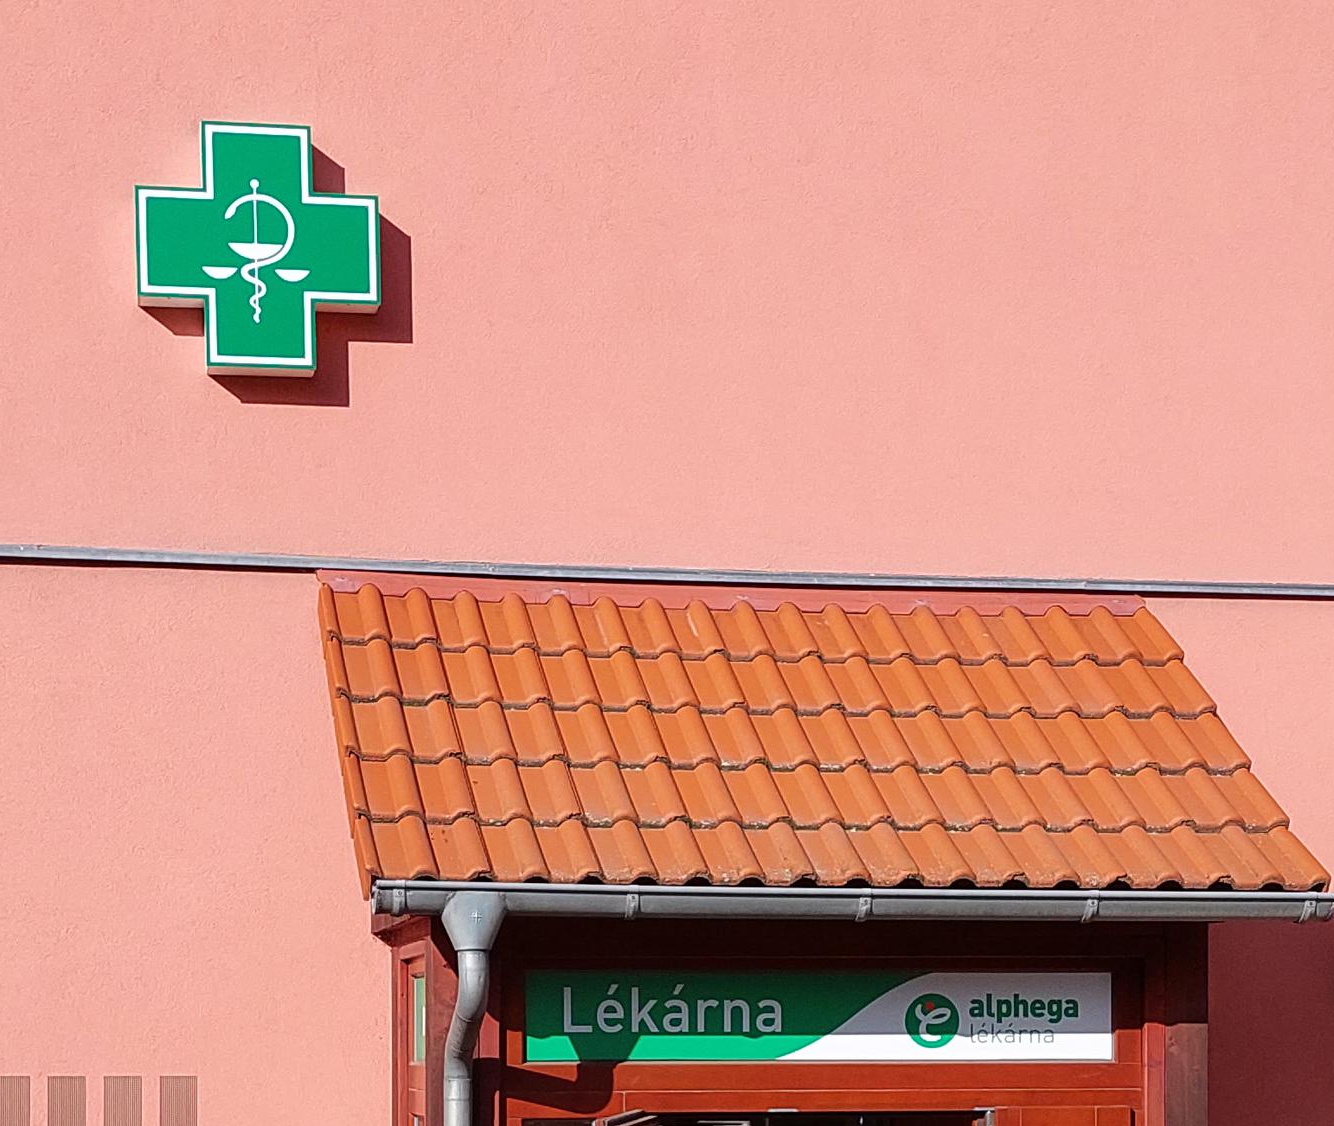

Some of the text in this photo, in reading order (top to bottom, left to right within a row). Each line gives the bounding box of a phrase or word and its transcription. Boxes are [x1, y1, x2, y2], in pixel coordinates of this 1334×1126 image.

[562, 983, 783, 1034] Lékárna
[968, 993, 1079, 1024] alphega
[969, 1022, 1055, 1045] lékárna
